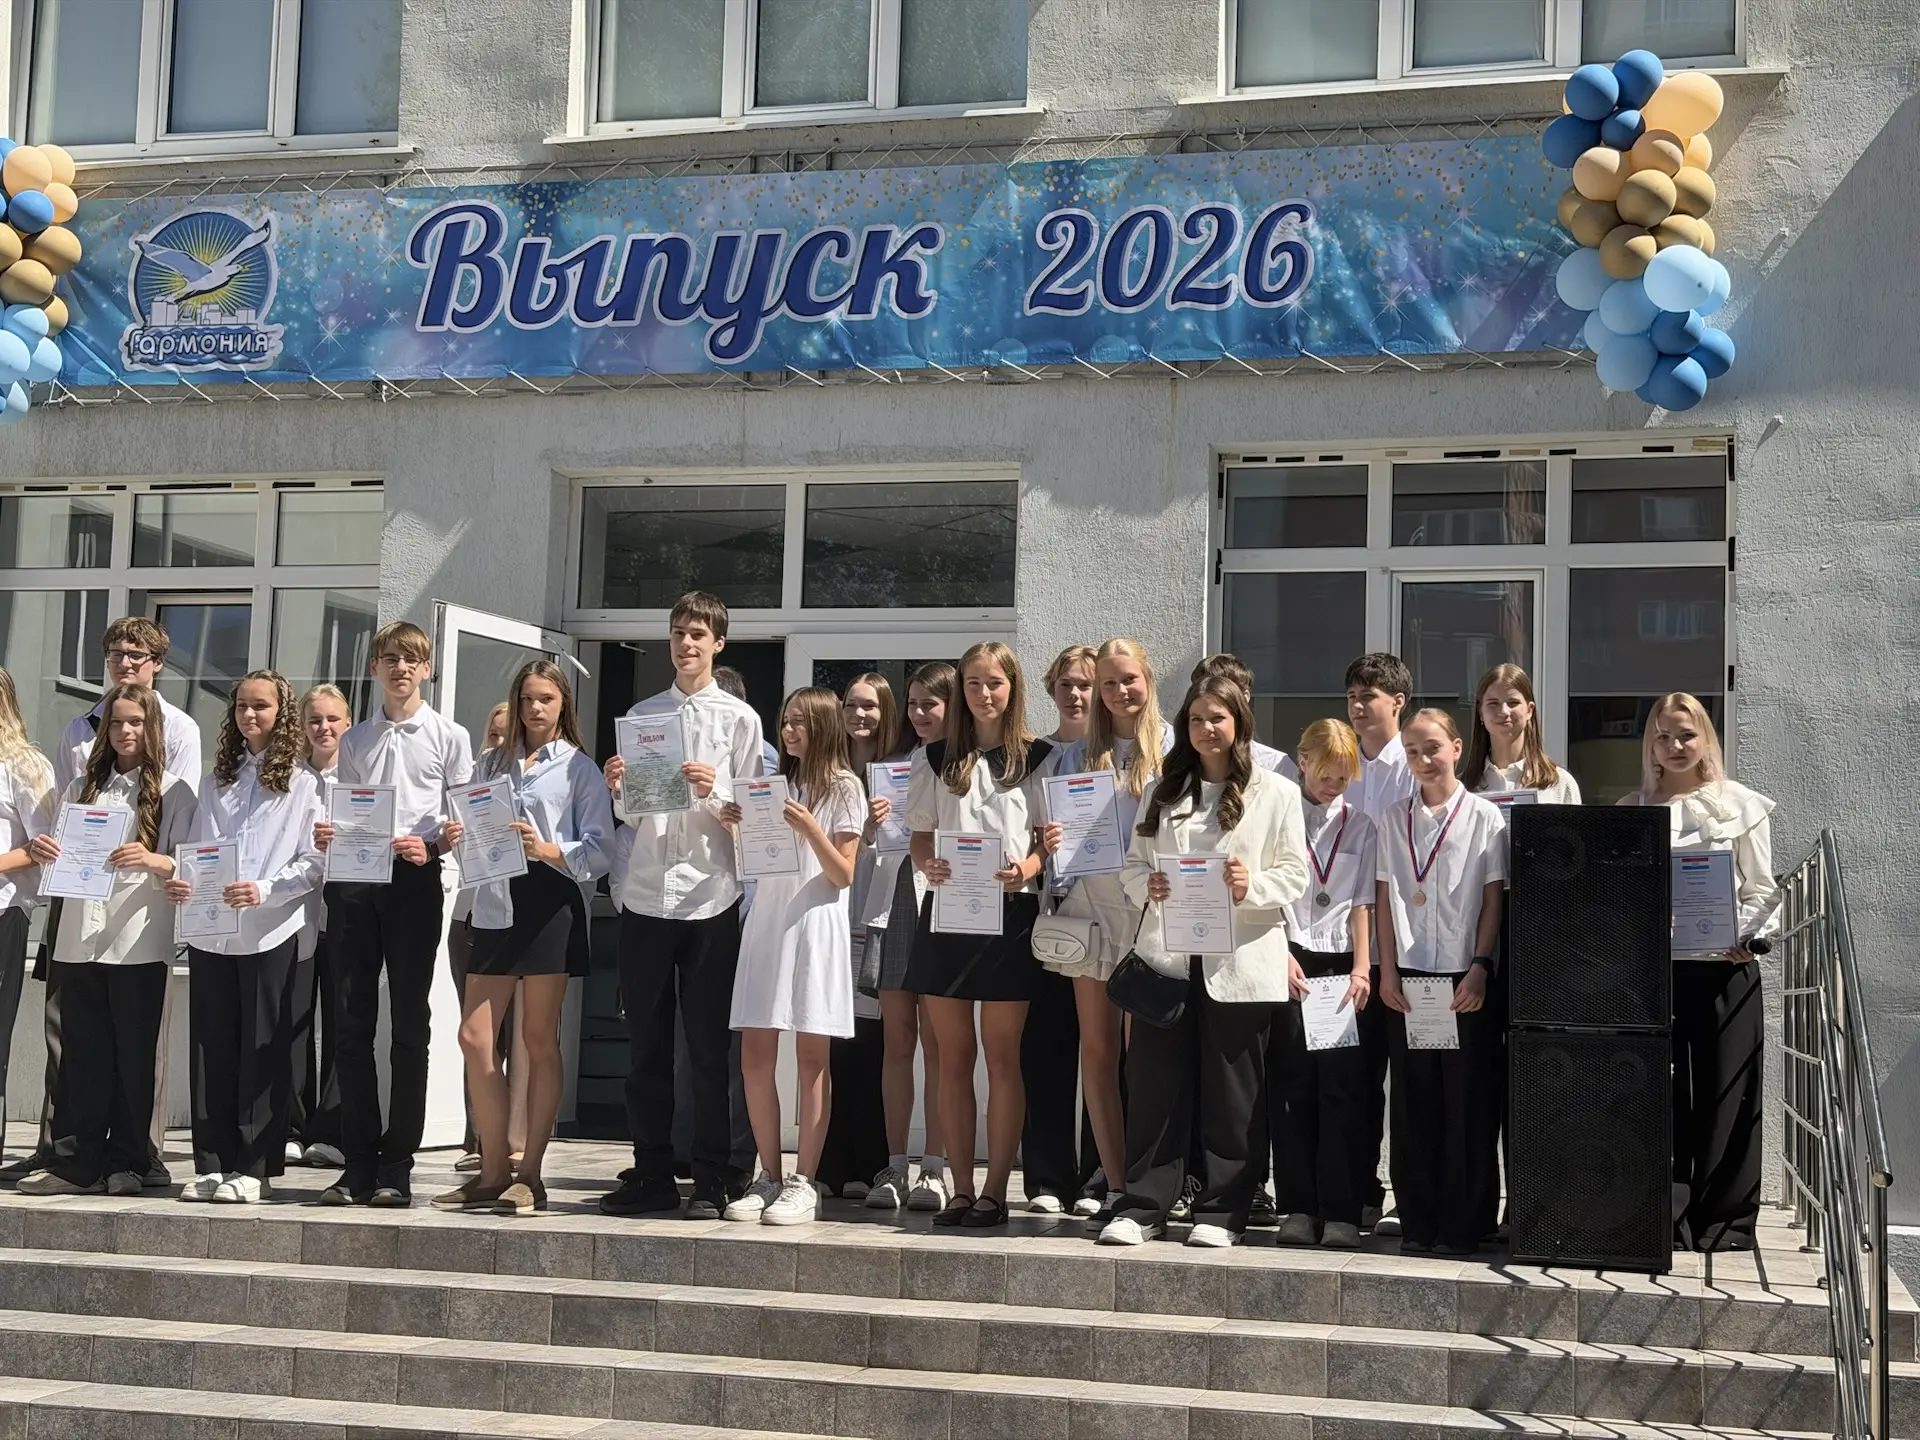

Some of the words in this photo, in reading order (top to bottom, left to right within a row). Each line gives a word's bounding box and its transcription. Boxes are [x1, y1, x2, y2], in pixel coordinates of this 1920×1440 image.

[407, 201, 941, 362] Выпуск
[1026, 200, 1314, 313] 2026
[129, 328, 270, 361] Гармония
